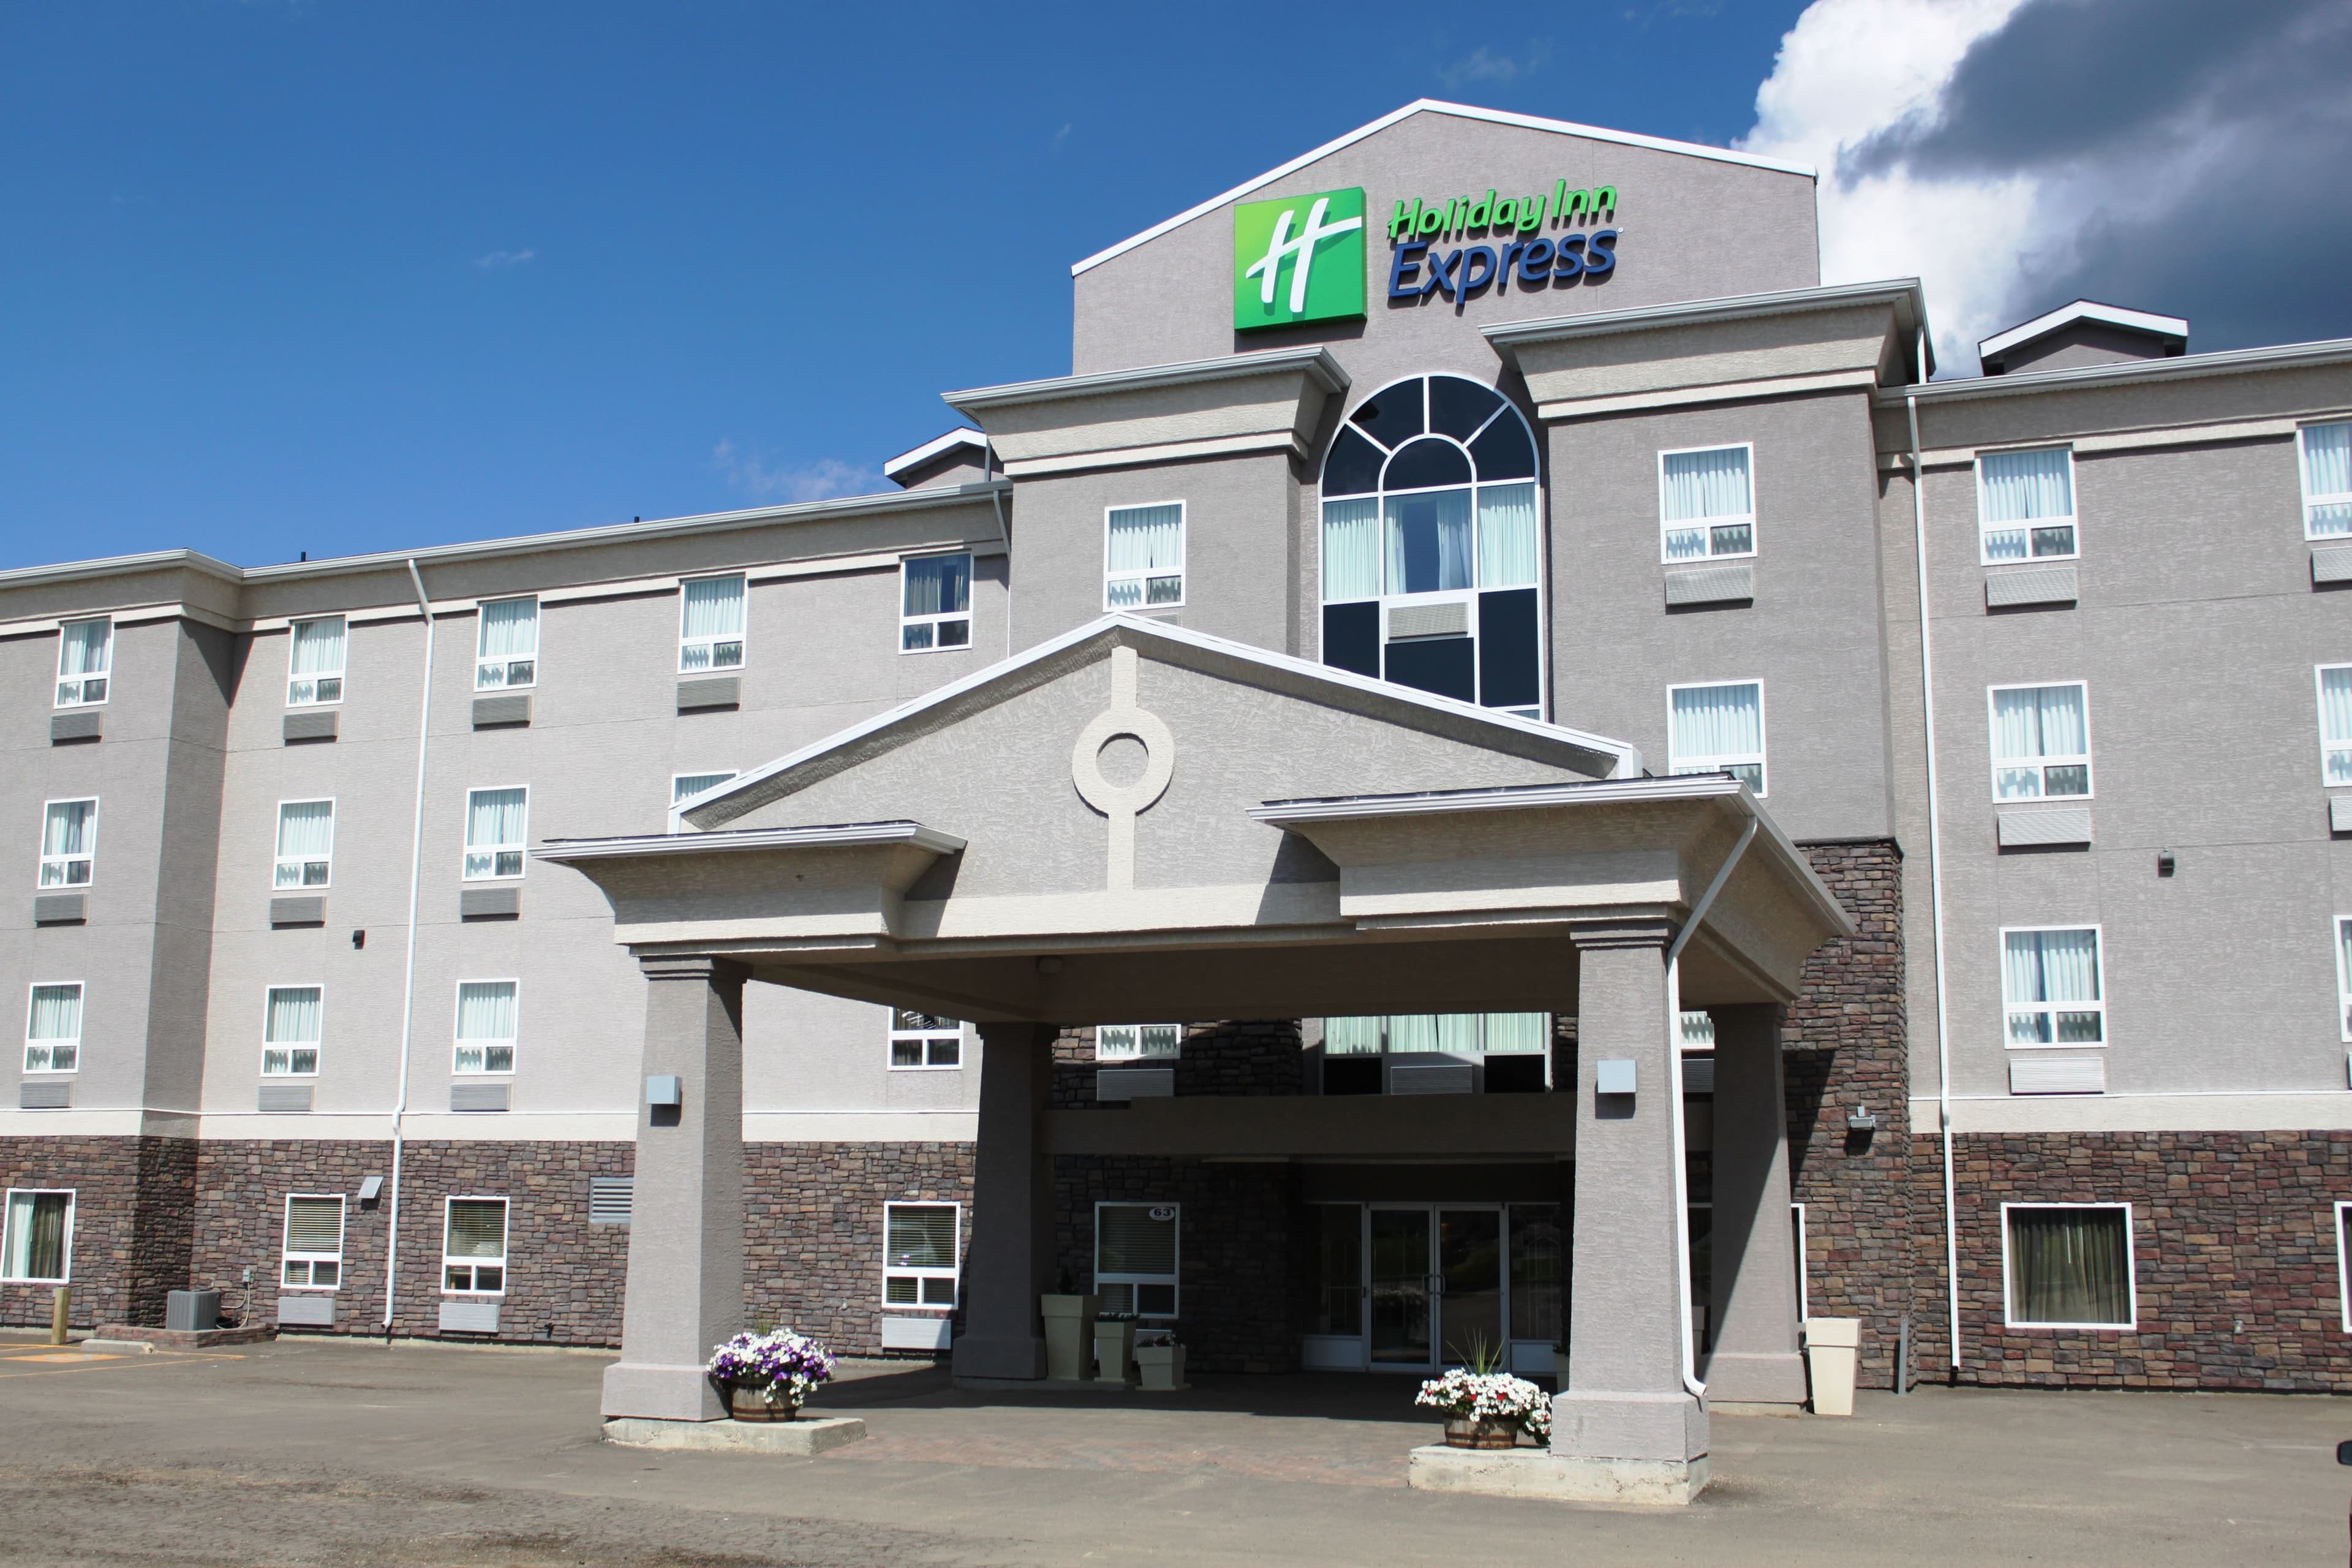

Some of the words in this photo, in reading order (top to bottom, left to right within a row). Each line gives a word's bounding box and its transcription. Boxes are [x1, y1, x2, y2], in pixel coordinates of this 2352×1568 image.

[1387, 189, 1547, 239] Holiday
[1551, 178, 1618, 219] Inn
[1387, 230, 1618, 304] Express
